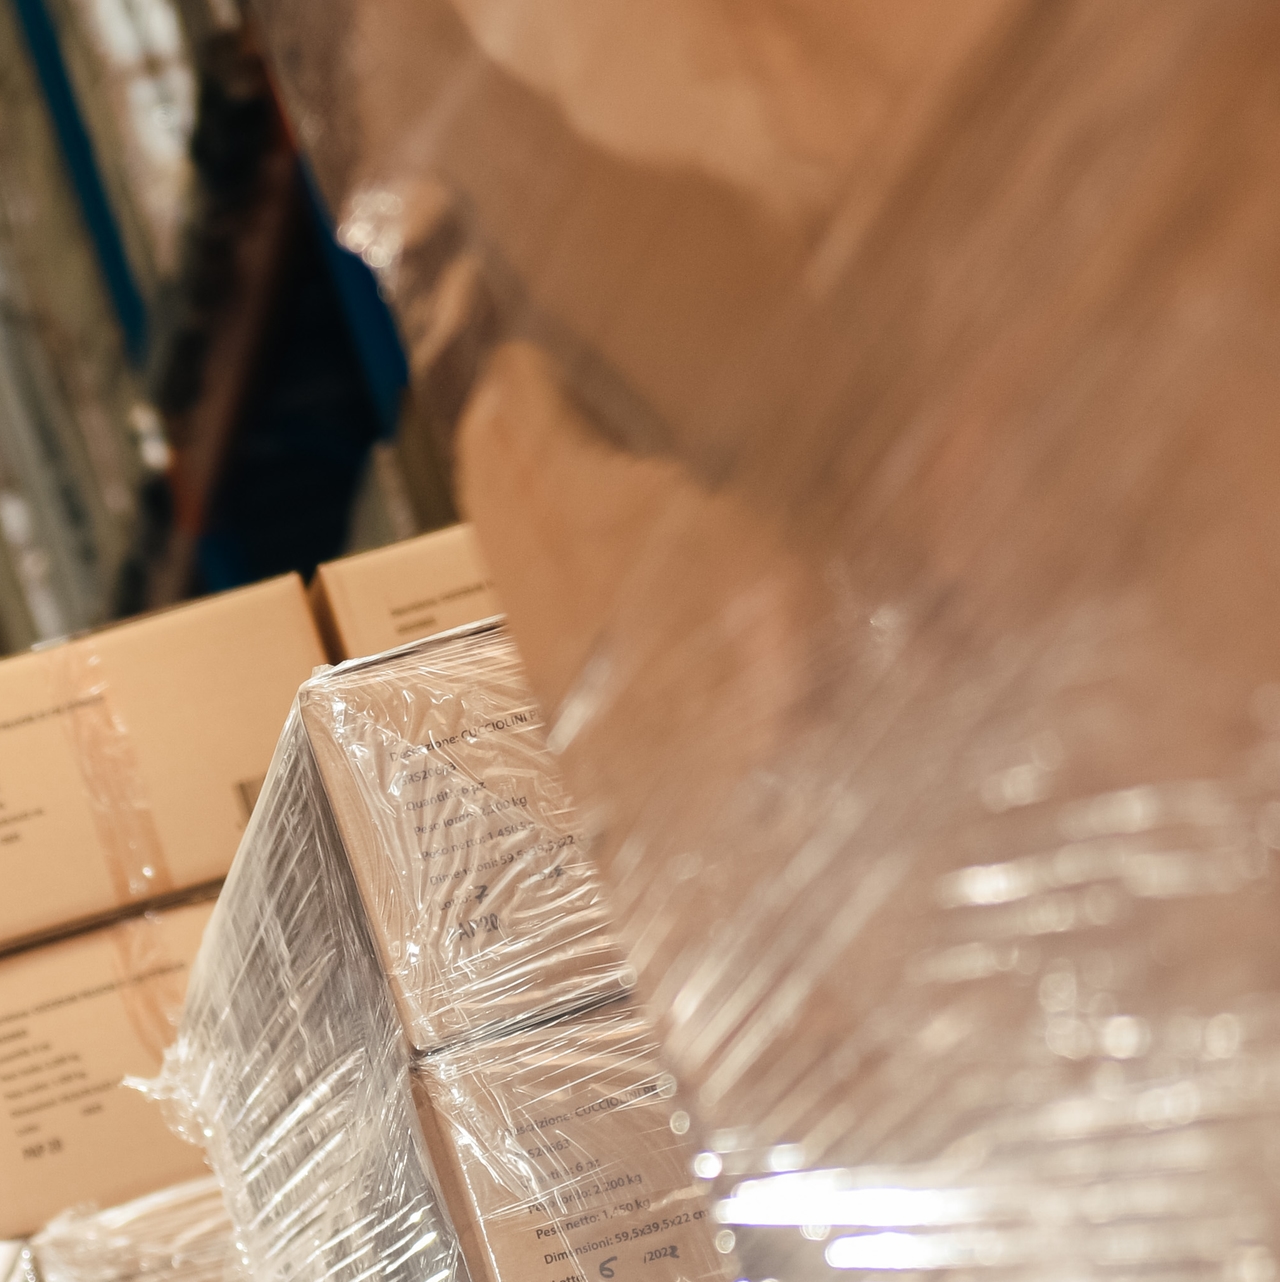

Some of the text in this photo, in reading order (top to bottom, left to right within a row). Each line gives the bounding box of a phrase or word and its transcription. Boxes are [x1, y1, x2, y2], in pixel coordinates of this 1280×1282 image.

[461, 785, 470, 796] 6
[513, 794, 528, 810] kg
[504, 1113, 574, 1137] escrizione:
[575, 1162, 584, 1173] 6
[626, 1172, 643, 1187] kg
[566, 1213, 602, 1232] netto:
[635, 1197, 652, 1213] kg
[614, 1213, 692, 1245] 59,5x39,5x22
